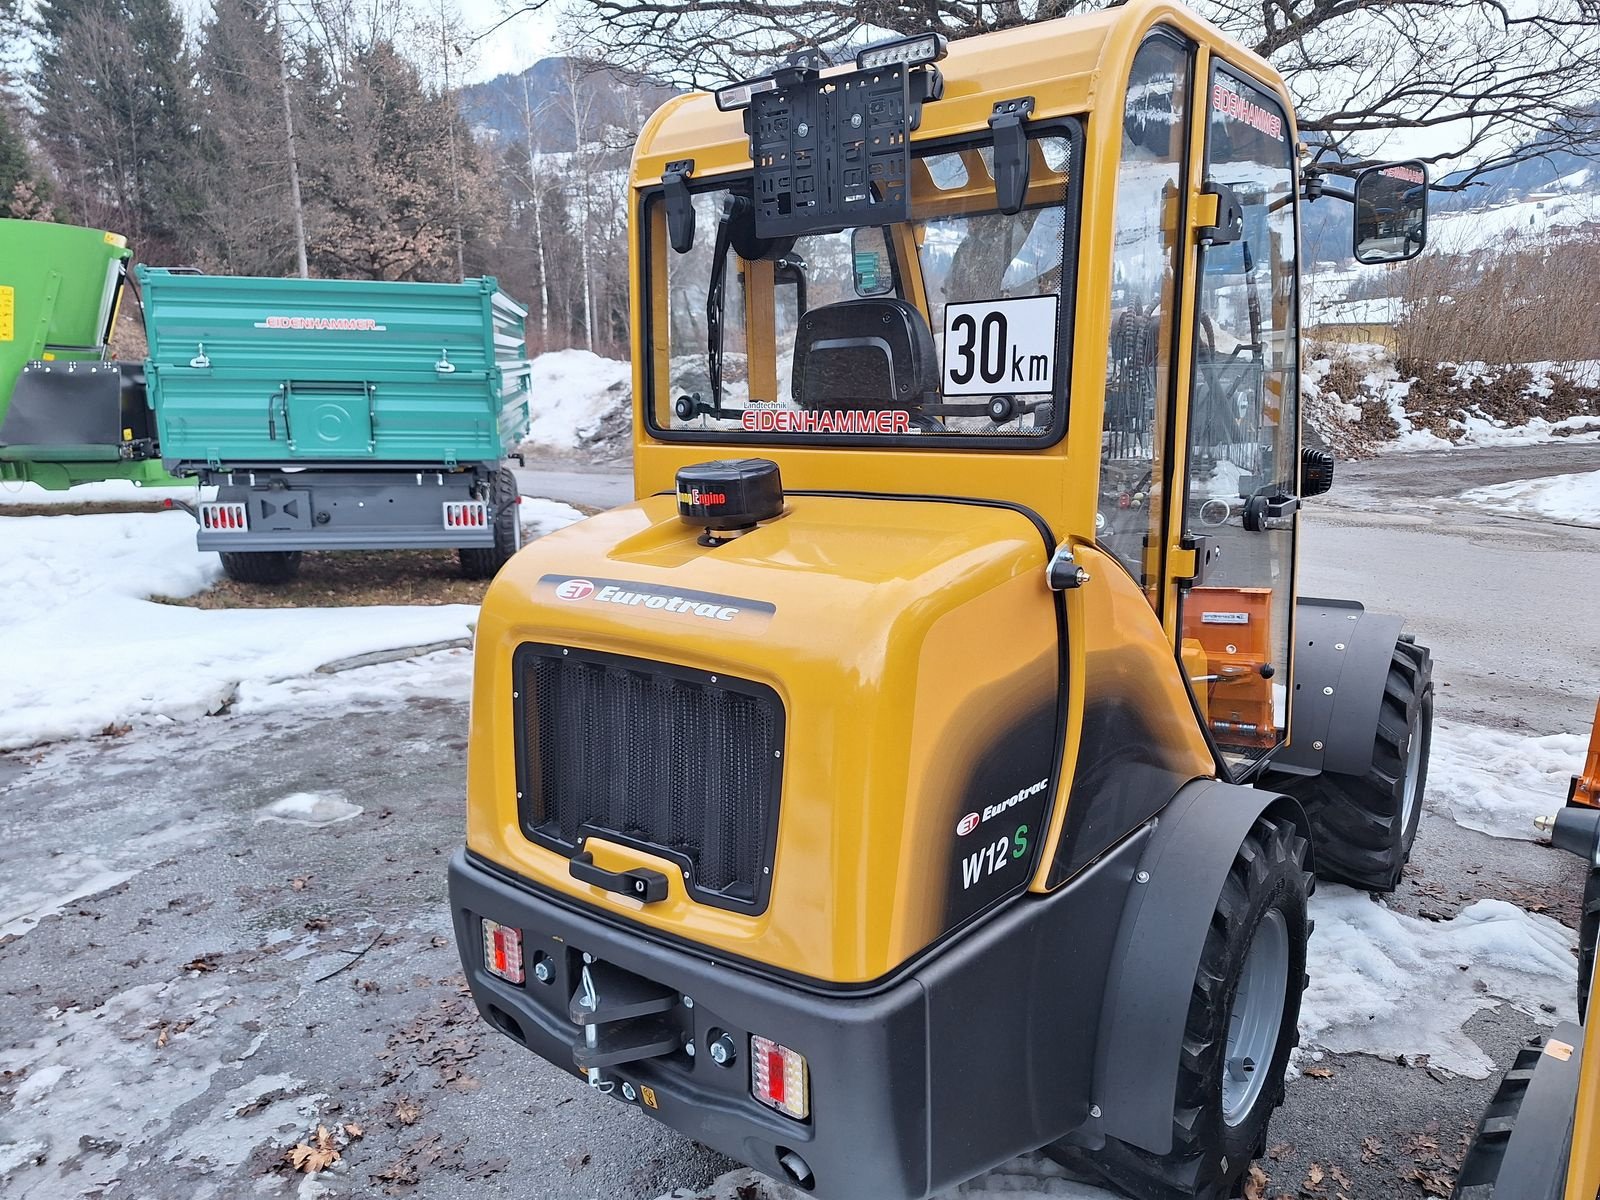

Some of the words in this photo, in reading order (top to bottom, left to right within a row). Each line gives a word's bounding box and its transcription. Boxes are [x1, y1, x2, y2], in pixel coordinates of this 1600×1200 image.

[1213, 84, 1281, 138] EIDENHAMMER
[266, 316, 376, 330] EIDENHAMMER
[950, 311, 1007, 385] 30
[1012, 344, 1048, 382] km
[742, 410, 909, 433] EIDENHAMMER
[744, 401, 787, 409] Landtechnik
[560, 581, 590, 599] ET
[595, 586, 740, 620] Eurotrac
[982, 778, 1048, 822] Eurotrac
[963, 837, 1009, 889] W12
[1012, 825, 1028, 858] S
